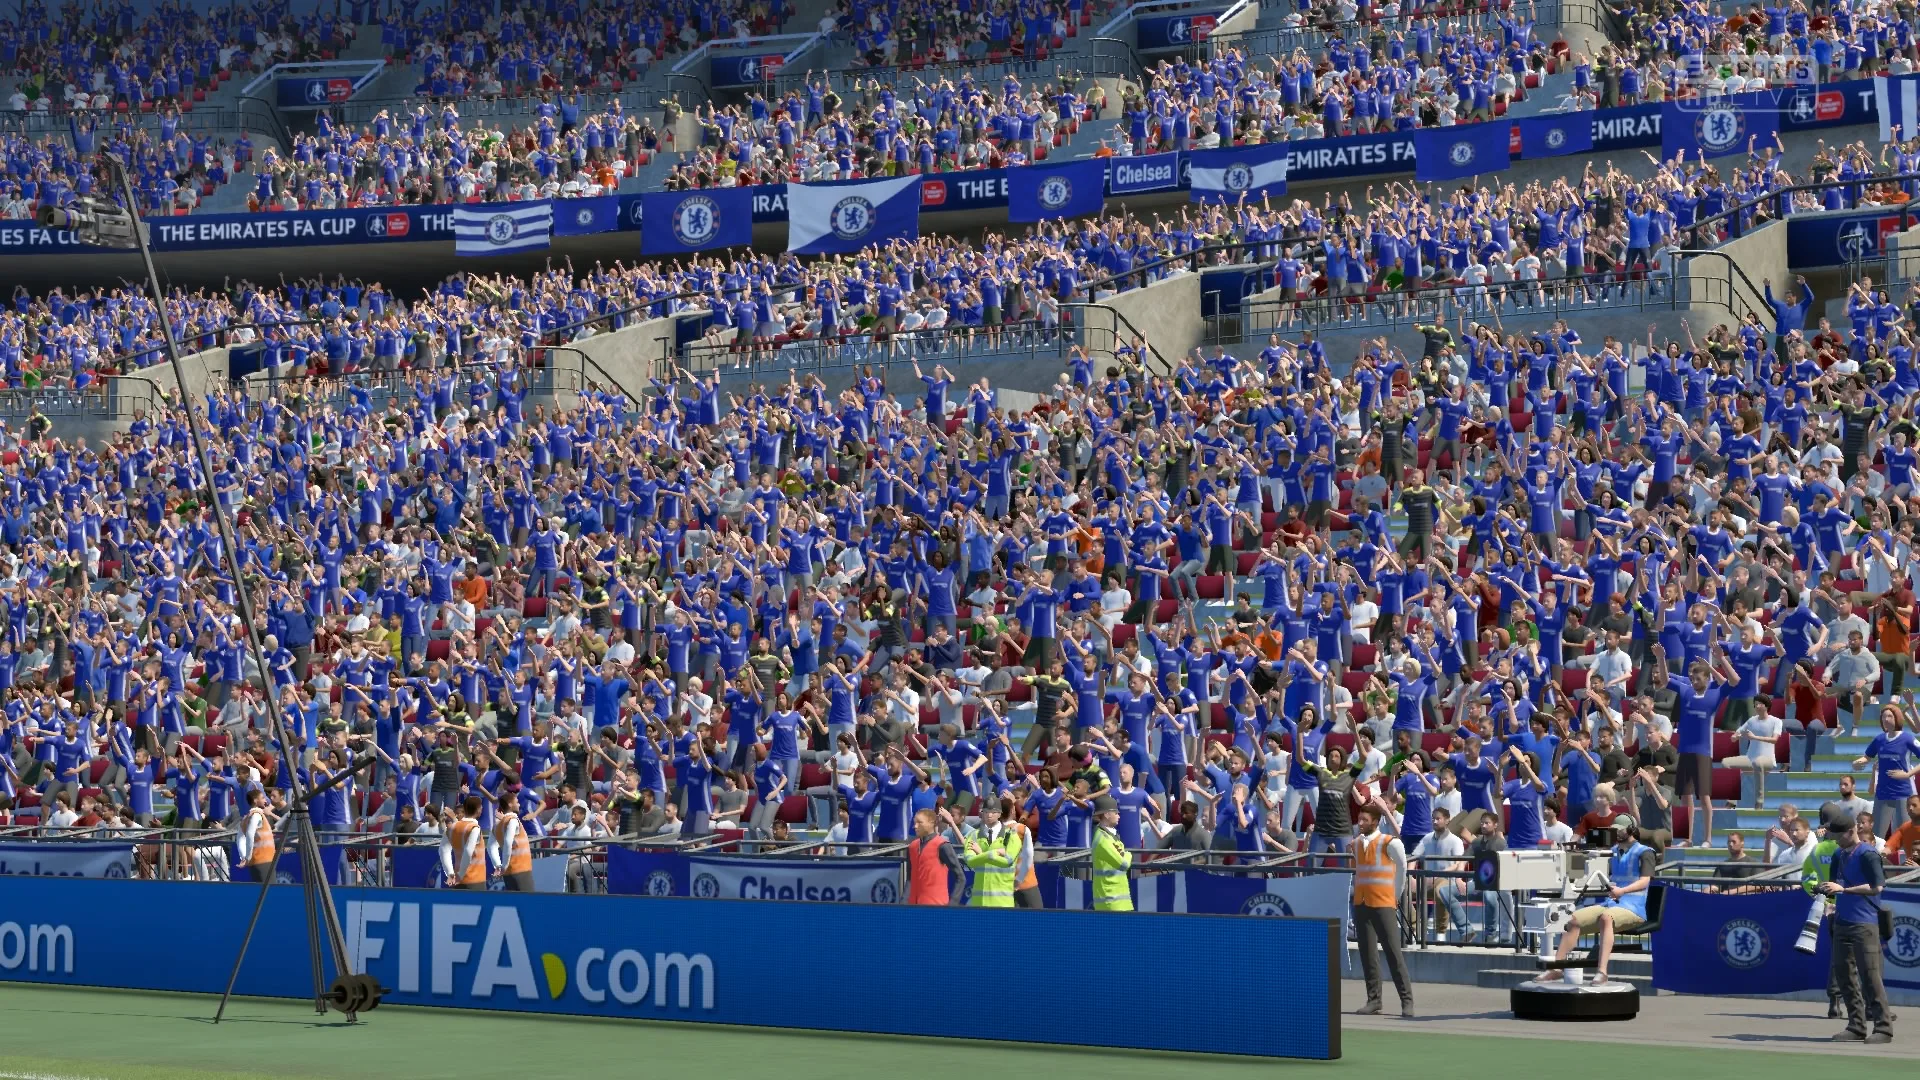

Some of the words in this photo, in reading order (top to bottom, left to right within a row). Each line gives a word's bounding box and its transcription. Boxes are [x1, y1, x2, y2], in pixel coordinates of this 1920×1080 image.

[1286, 143, 1387, 170] EMIRATES
[1392, 141, 1416, 161] FA
[1116, 163, 1172, 184] Chelsea
[957, 179, 996, 200] THE
[160, 225, 195, 242] THE
[200, 220, 288, 240] EMIRATES
[293, 219, 315, 237] FA
[320, 218, 356, 235] CUP
[420, 213, 455, 231] THE
[29, 228, 53, 245] FA
[58, 228, 80, 245] CU
[739, 875, 851, 902] Chelsea
[1248, 895, 1285, 909] CHELSEA
[1726, 920, 1760, 933] CHELSEA
